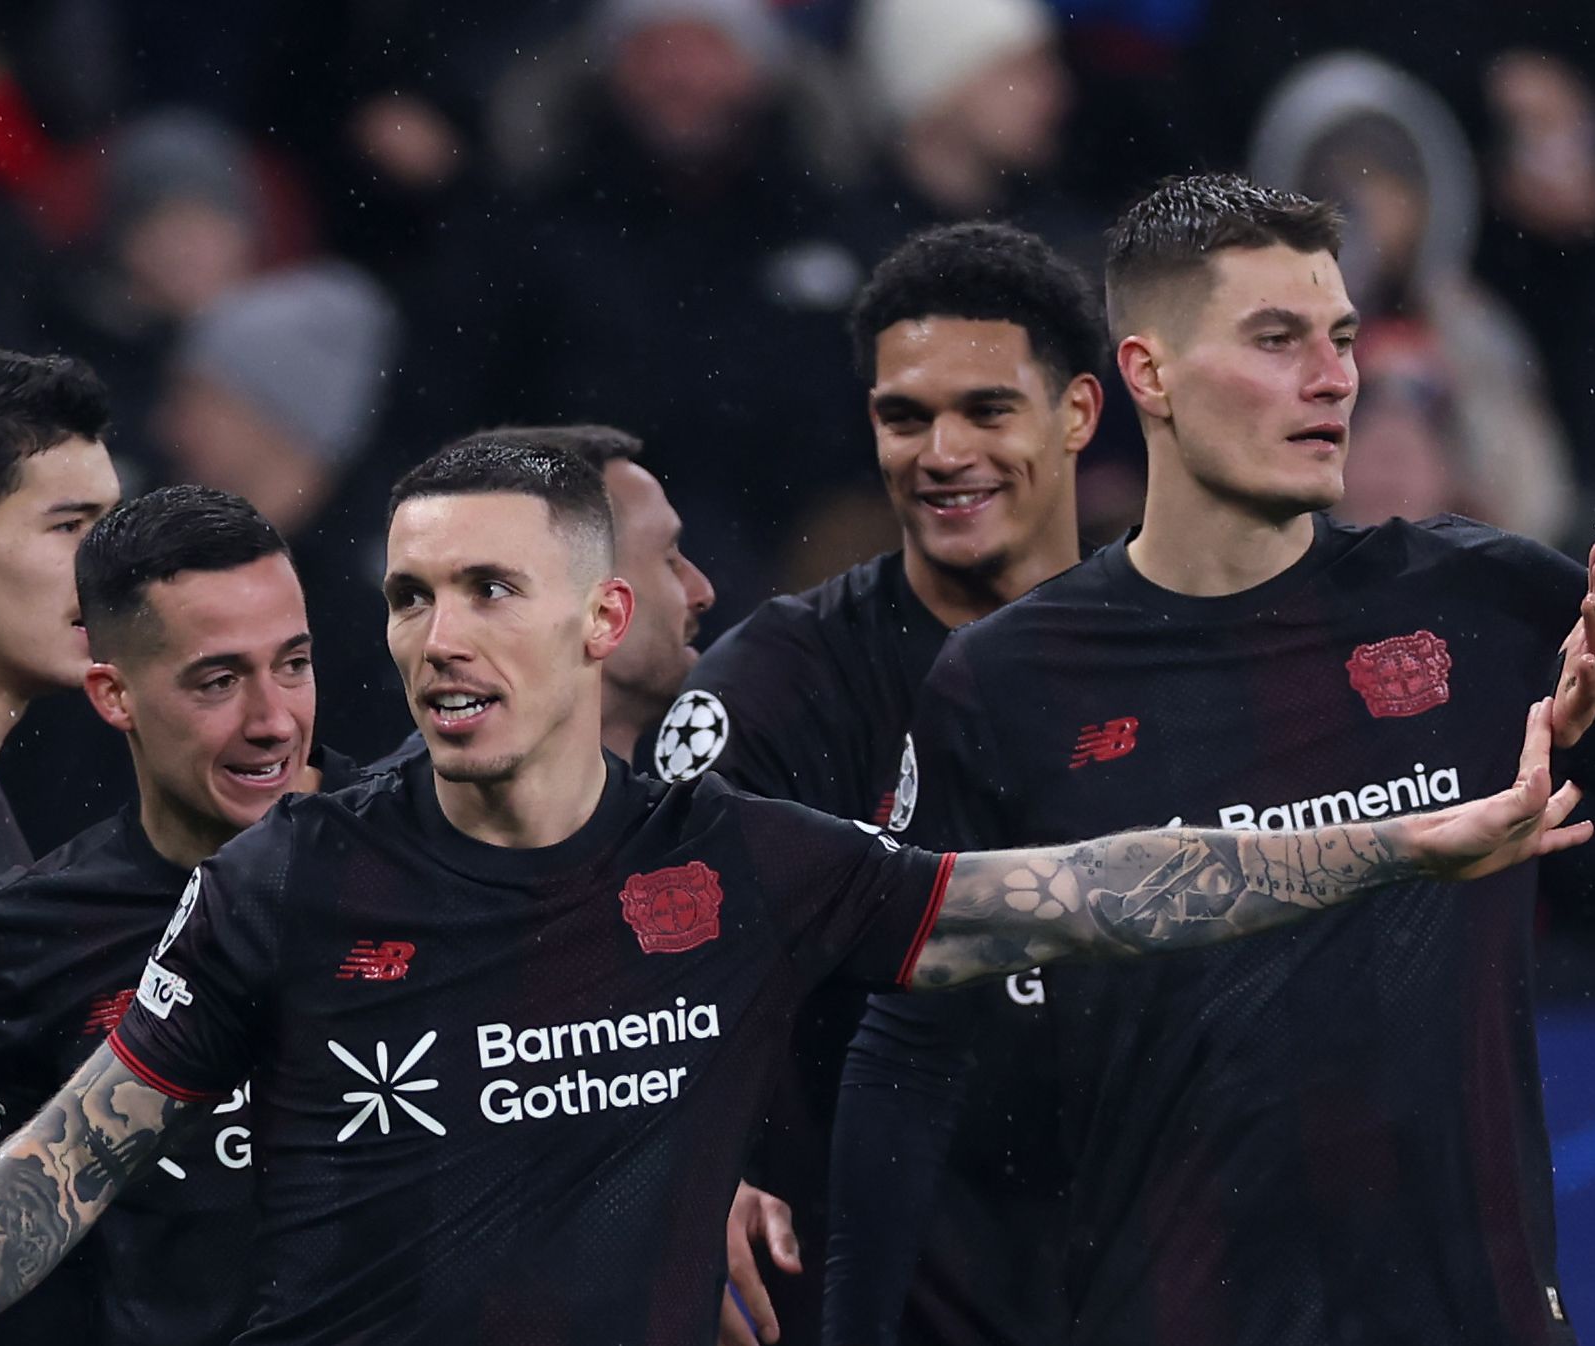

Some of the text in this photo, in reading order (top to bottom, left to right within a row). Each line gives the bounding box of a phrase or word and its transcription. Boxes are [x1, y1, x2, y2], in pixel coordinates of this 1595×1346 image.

[1218, 762, 1461, 832] Barmenia
[476, 996, 721, 1069] Barmenia
[479, 1066, 688, 1124] Gothaer
